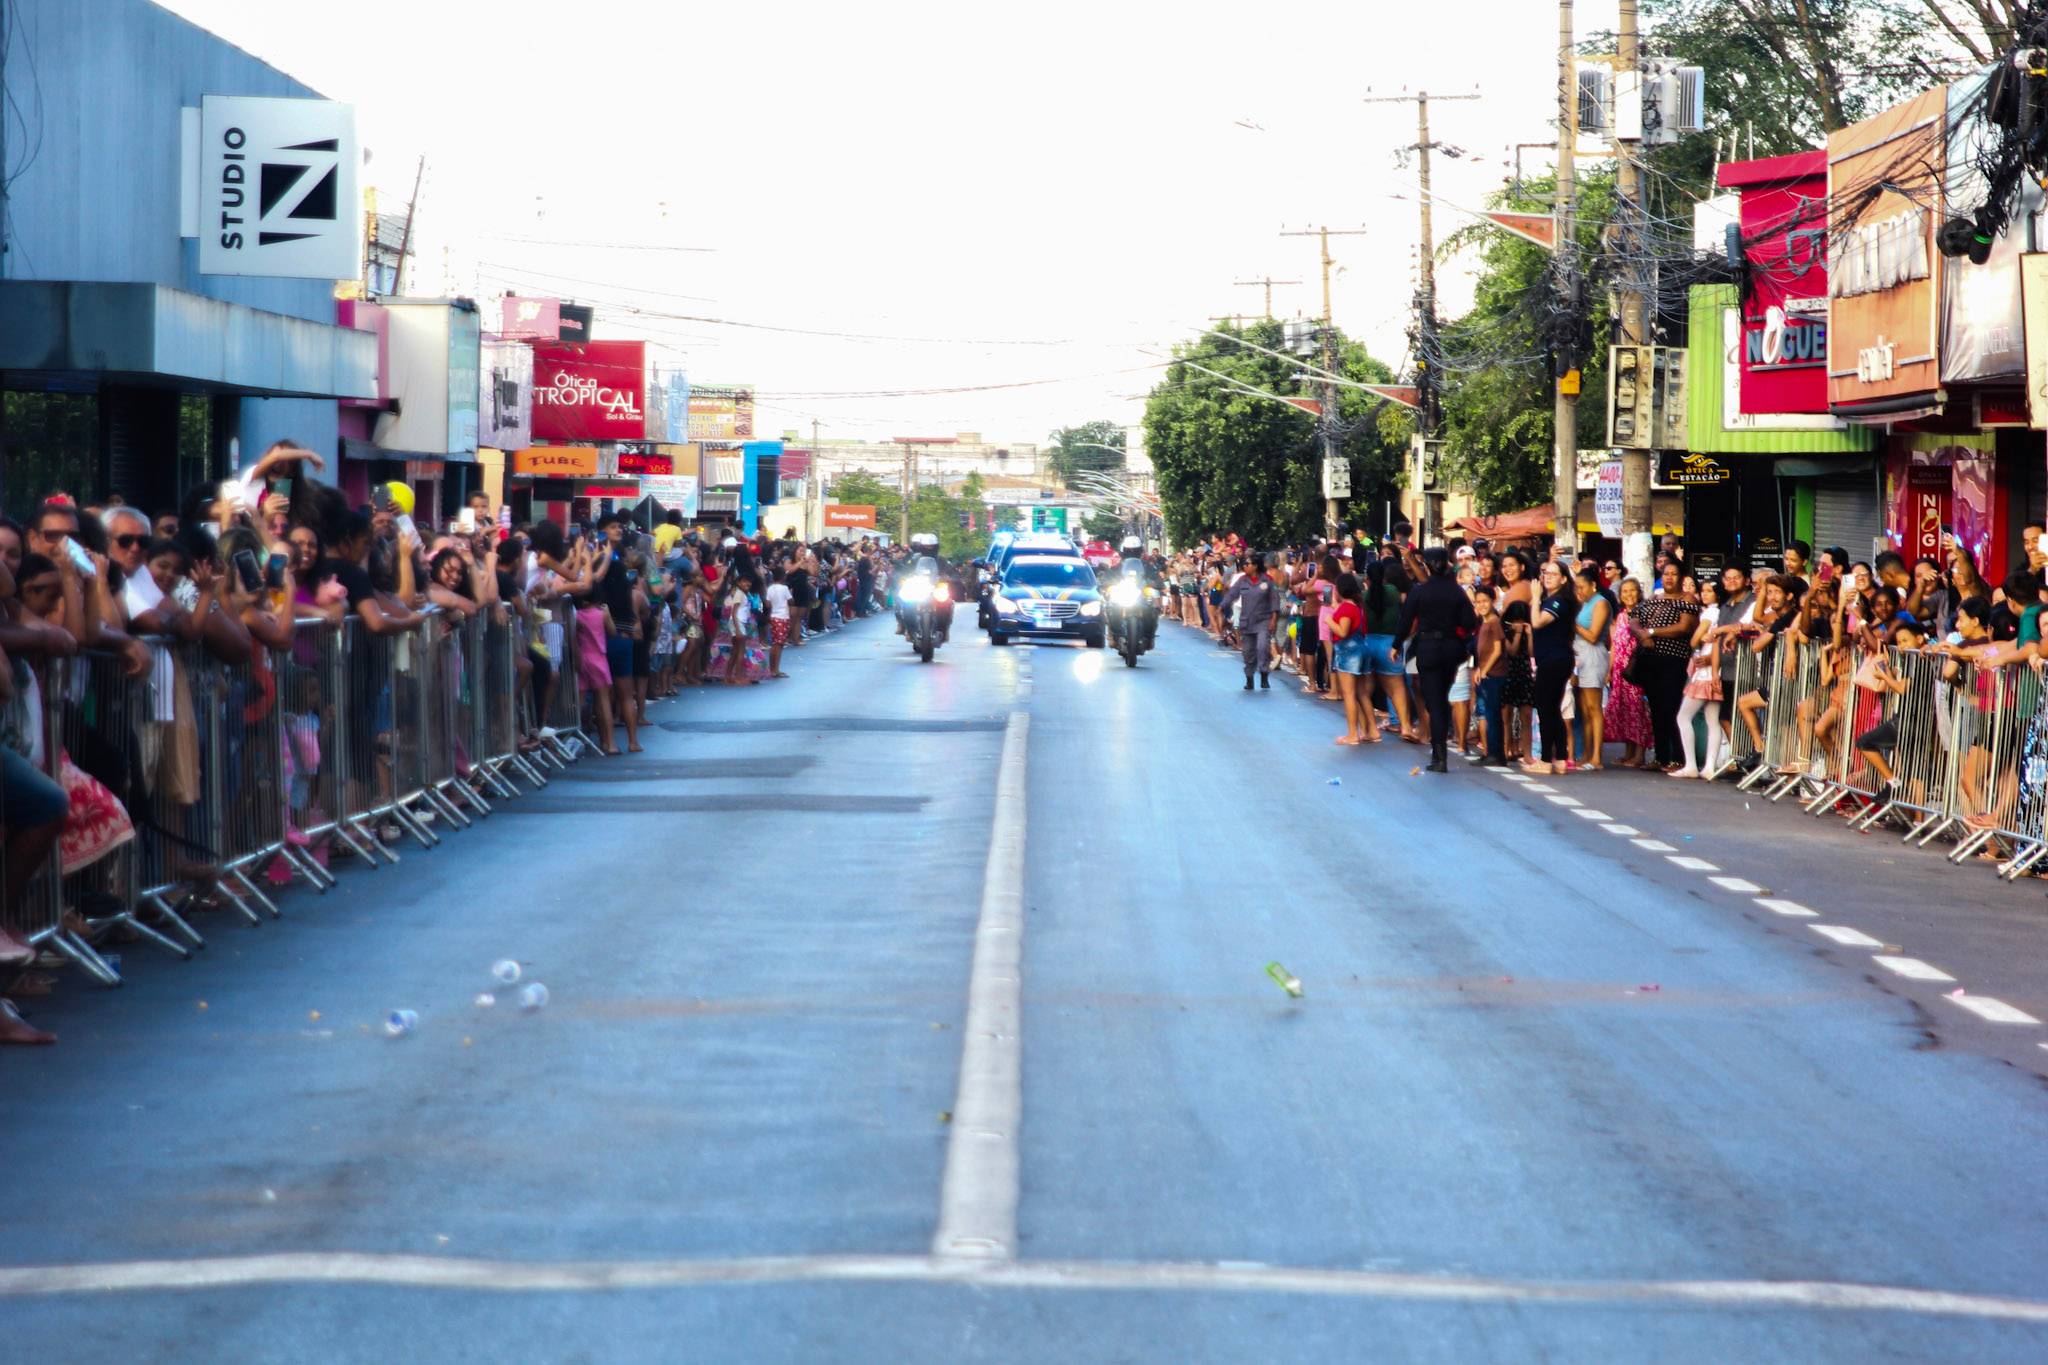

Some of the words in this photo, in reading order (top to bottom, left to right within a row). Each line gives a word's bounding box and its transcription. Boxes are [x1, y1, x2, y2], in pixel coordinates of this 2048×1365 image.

[221, 127, 246, 250] STUDIO
[555, 369, 597, 389] Ótica
[534, 386, 640, 413] TROPICAL
[528, 456, 584, 468] TUBE
[1685, 466, 1714, 474] ÓTICA
[1680, 473, 1720, 482] ESTAÇÃO
